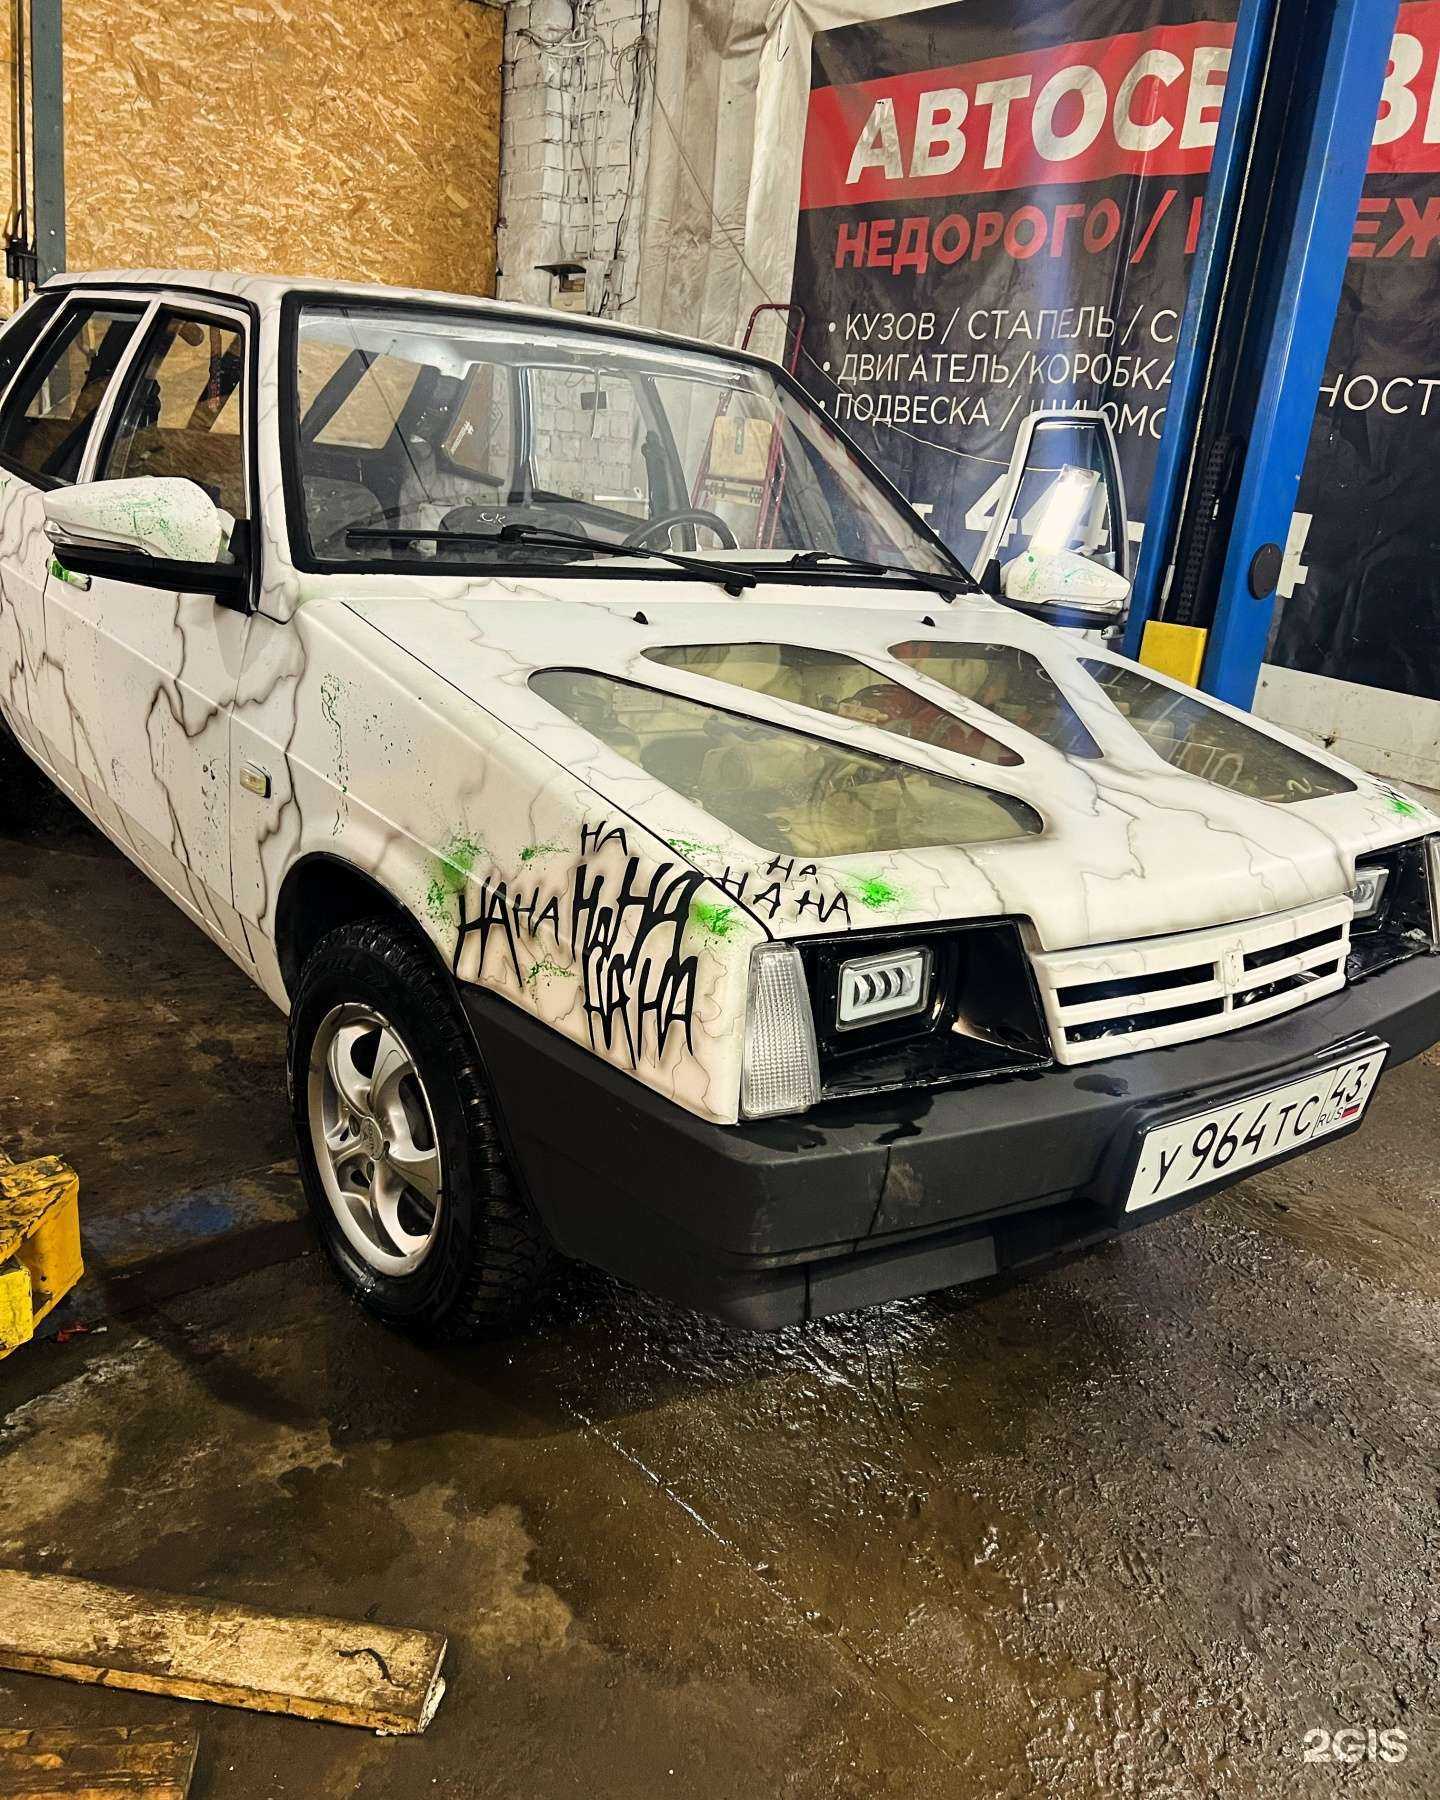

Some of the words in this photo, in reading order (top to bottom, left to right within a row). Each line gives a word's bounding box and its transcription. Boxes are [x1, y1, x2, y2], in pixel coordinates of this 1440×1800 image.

[835, 198, 1121, 276] НЕДОРОГО
[845, 312, 936, 342] КУЗОВ
[967, 306, 1116, 342] СТАПЕЛЬ
[834, 393, 991, 428] ПОДВЕСКА
[1331, 1063, 1371, 1108] 43
[1317, 1108, 1343, 1130] RUS
